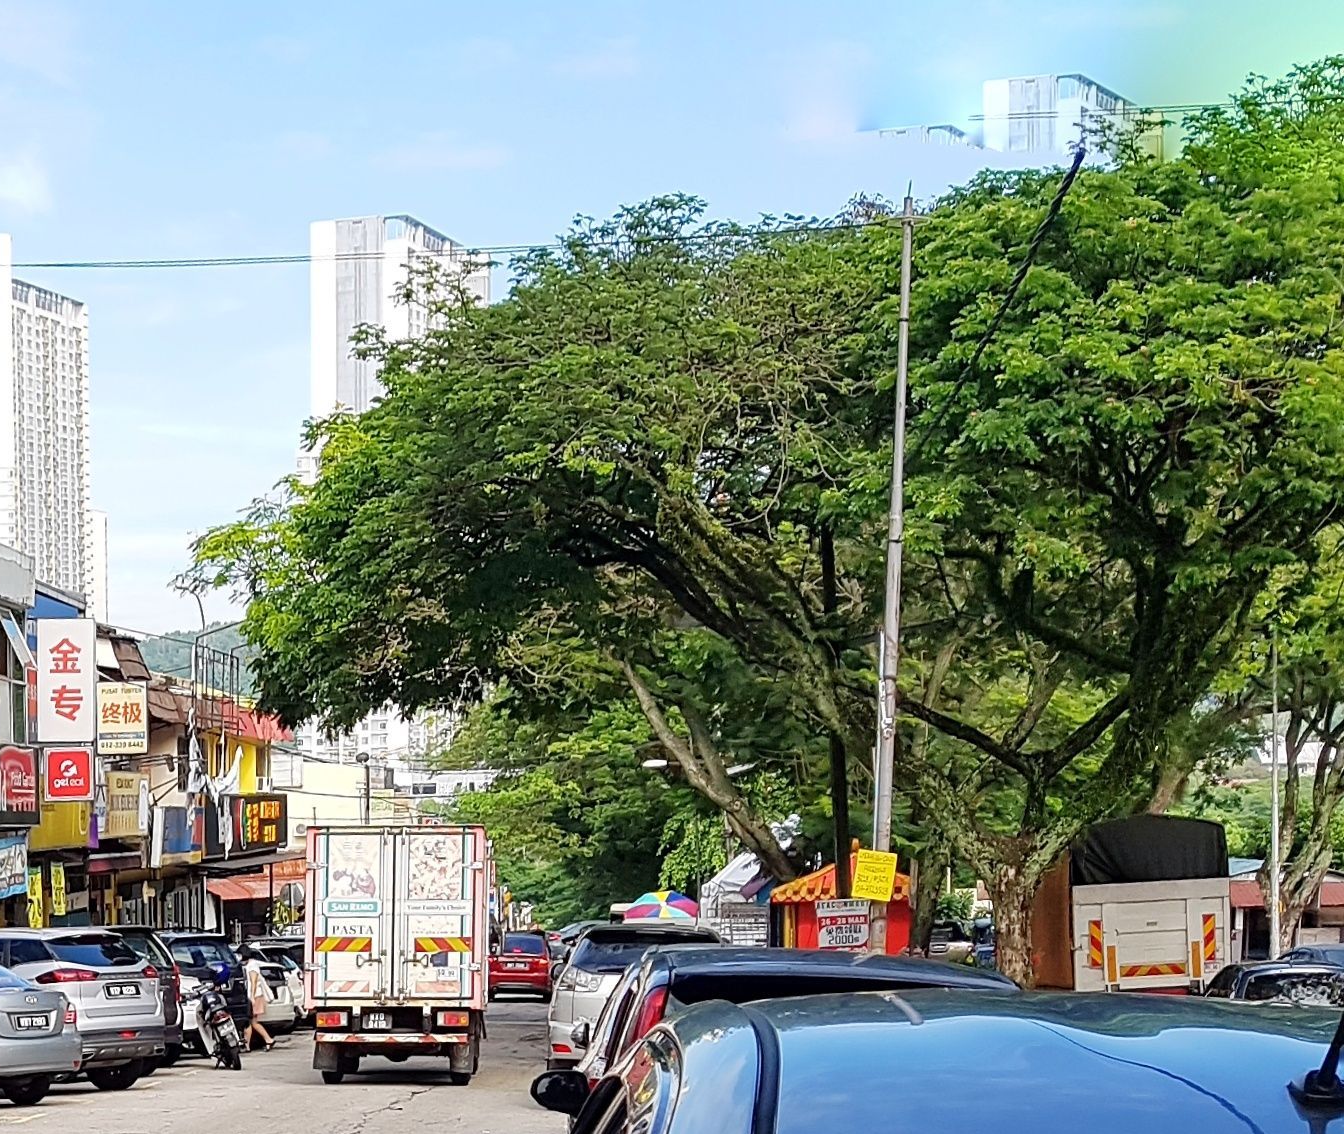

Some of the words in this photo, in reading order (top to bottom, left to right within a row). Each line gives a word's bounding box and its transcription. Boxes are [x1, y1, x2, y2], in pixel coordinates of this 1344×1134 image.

[48, 638, 83, 721] 金专
[101, 702, 142, 724] 终极
[331, 902, 349, 911] SAN
[332, 925, 374, 935] PASTA
